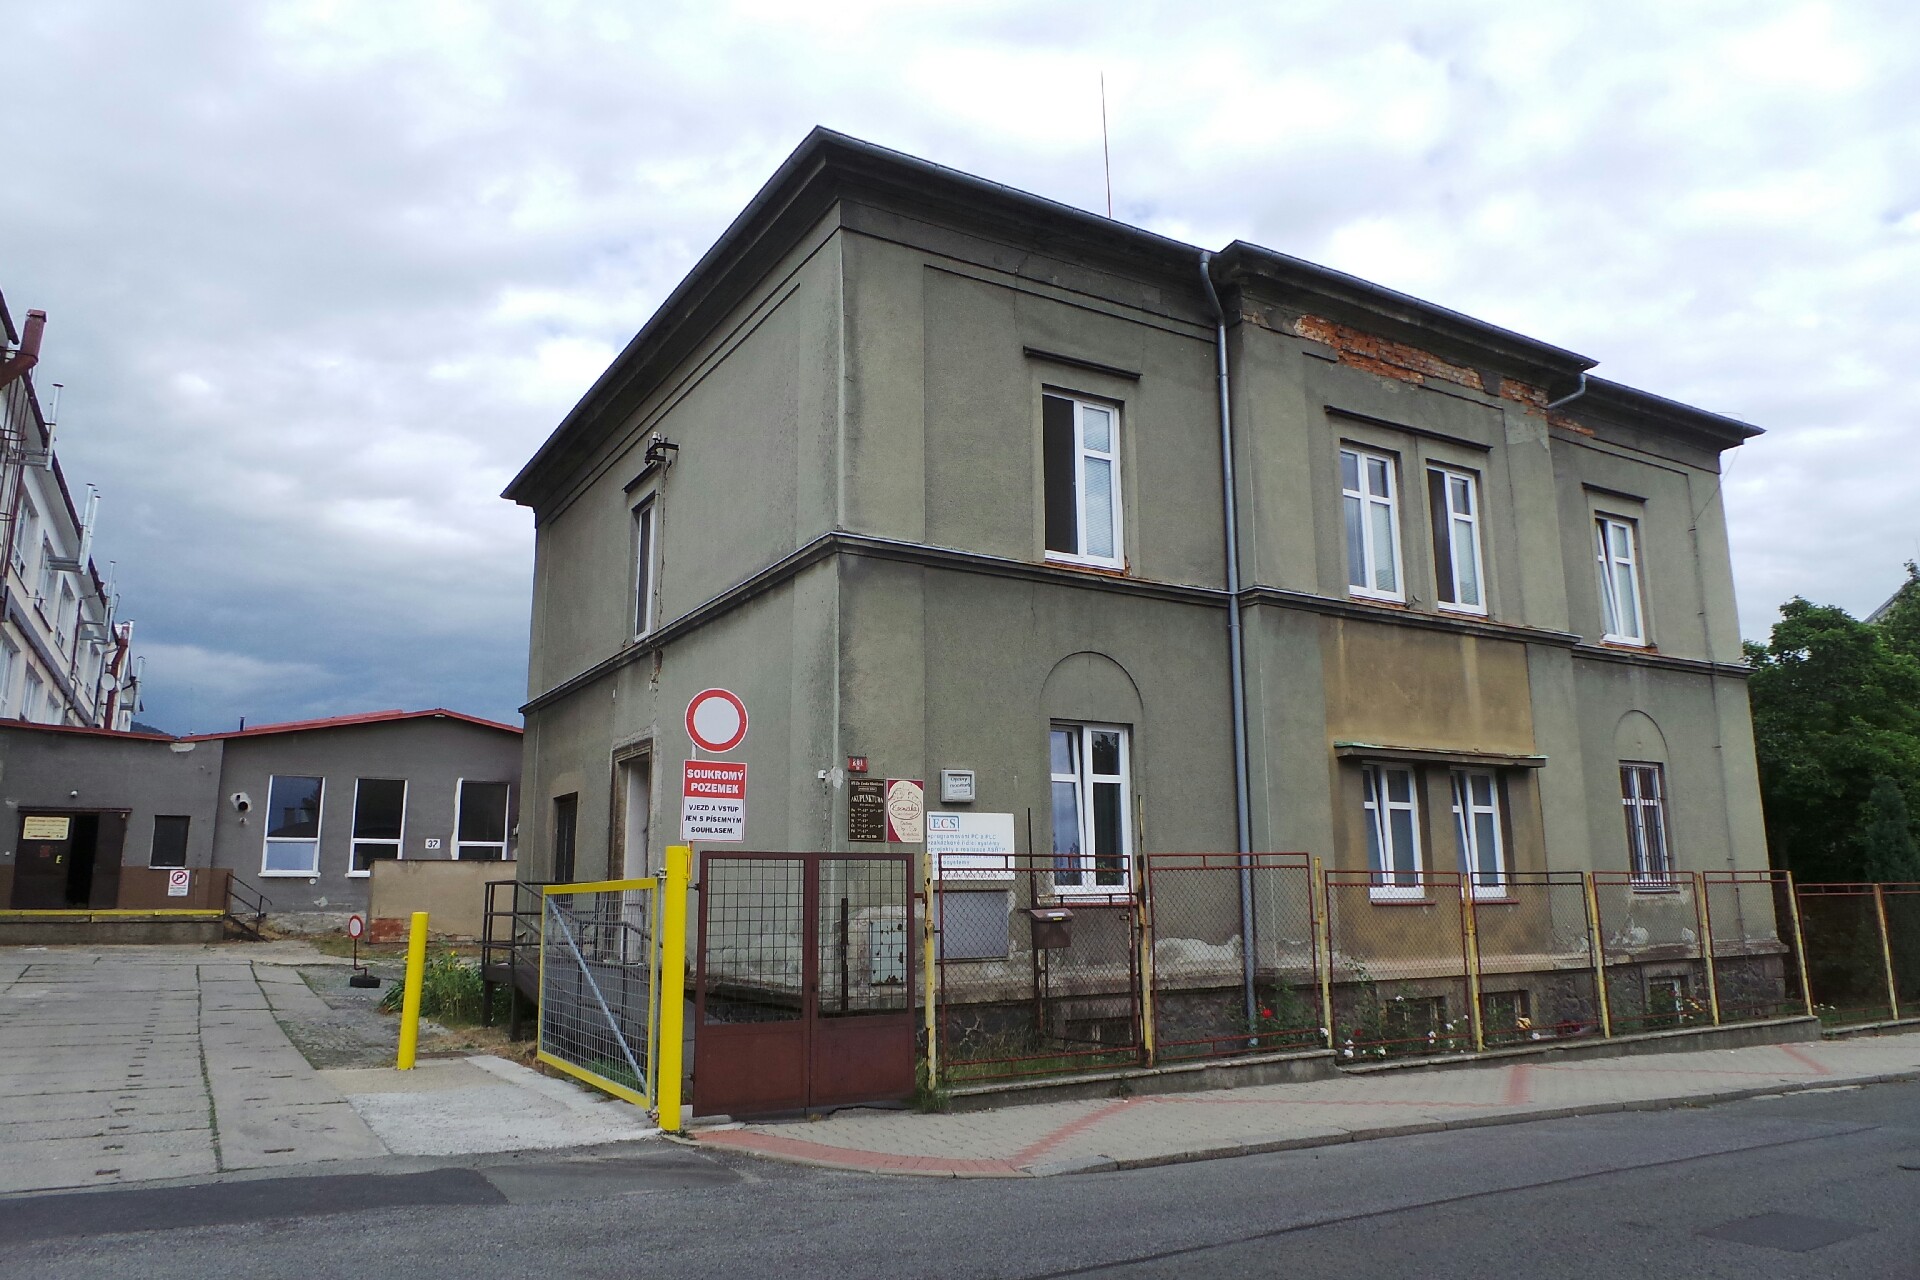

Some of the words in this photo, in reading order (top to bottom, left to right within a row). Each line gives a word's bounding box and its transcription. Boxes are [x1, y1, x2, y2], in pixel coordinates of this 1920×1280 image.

[686, 769, 744, 781] SOUKROMÝ
[690, 783, 739, 793] POZEMEK
[705, 815, 742, 824] PÍSEMNÝM
[933, 818, 956, 829] ECS
[690, 826, 735, 835] SOUHLASEM.
[427, 839, 439, 848] 37
